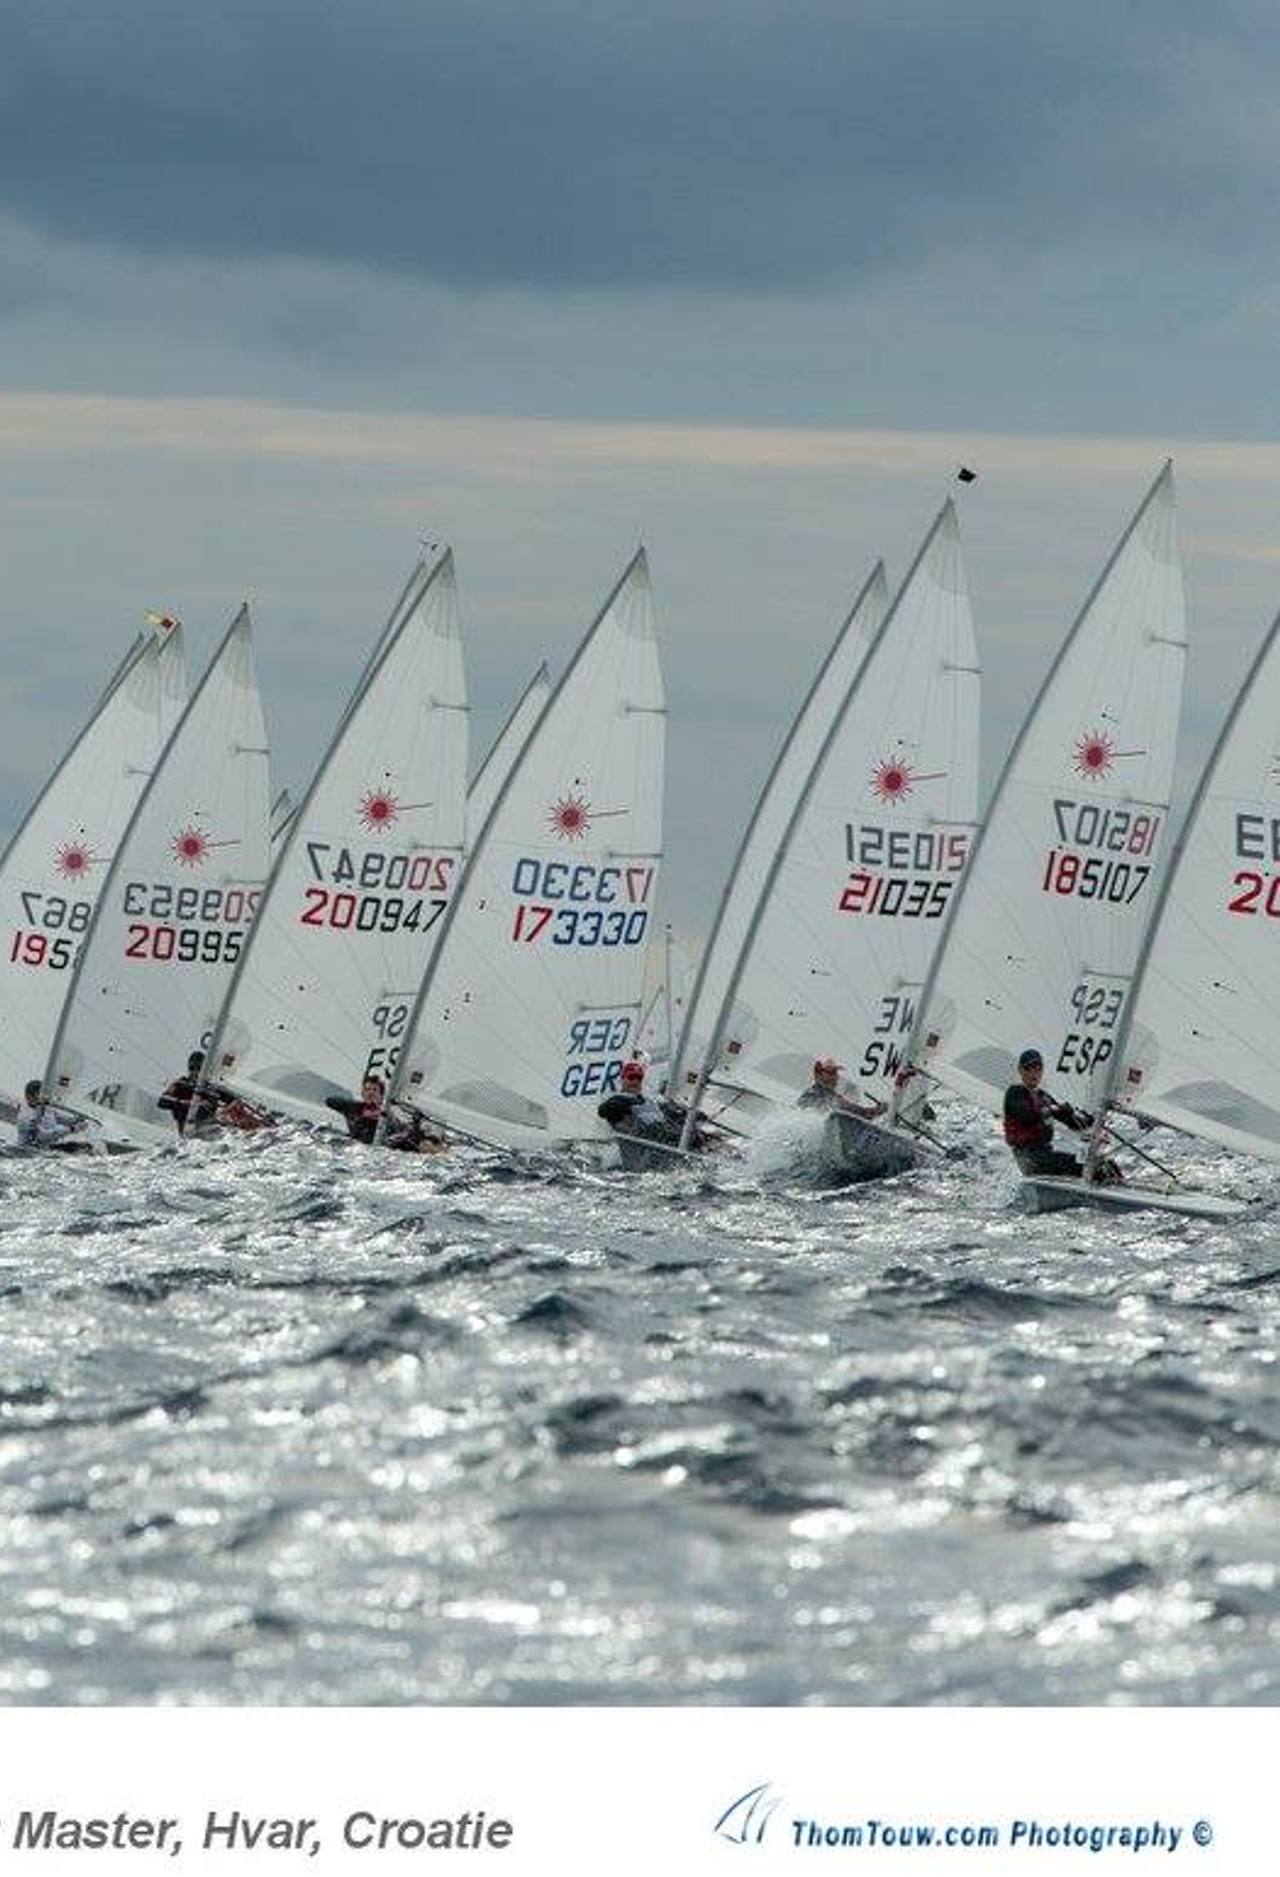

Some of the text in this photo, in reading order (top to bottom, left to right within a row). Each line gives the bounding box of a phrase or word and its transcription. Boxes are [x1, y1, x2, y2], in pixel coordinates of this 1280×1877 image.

[838, 871, 952, 918] 21035
[1042, 849, 1150, 905] 185107
[300, 887, 449, 933] 200947
[512, 906, 648, 946] 173330
[10, 931, 83, 970] 195
[124, 924, 245, 963] 20995
[859, 1041, 906, 1077] SW
[1055, 1034, 1113, 1076] ESP
[560, 1061, 625, 1097] GER
